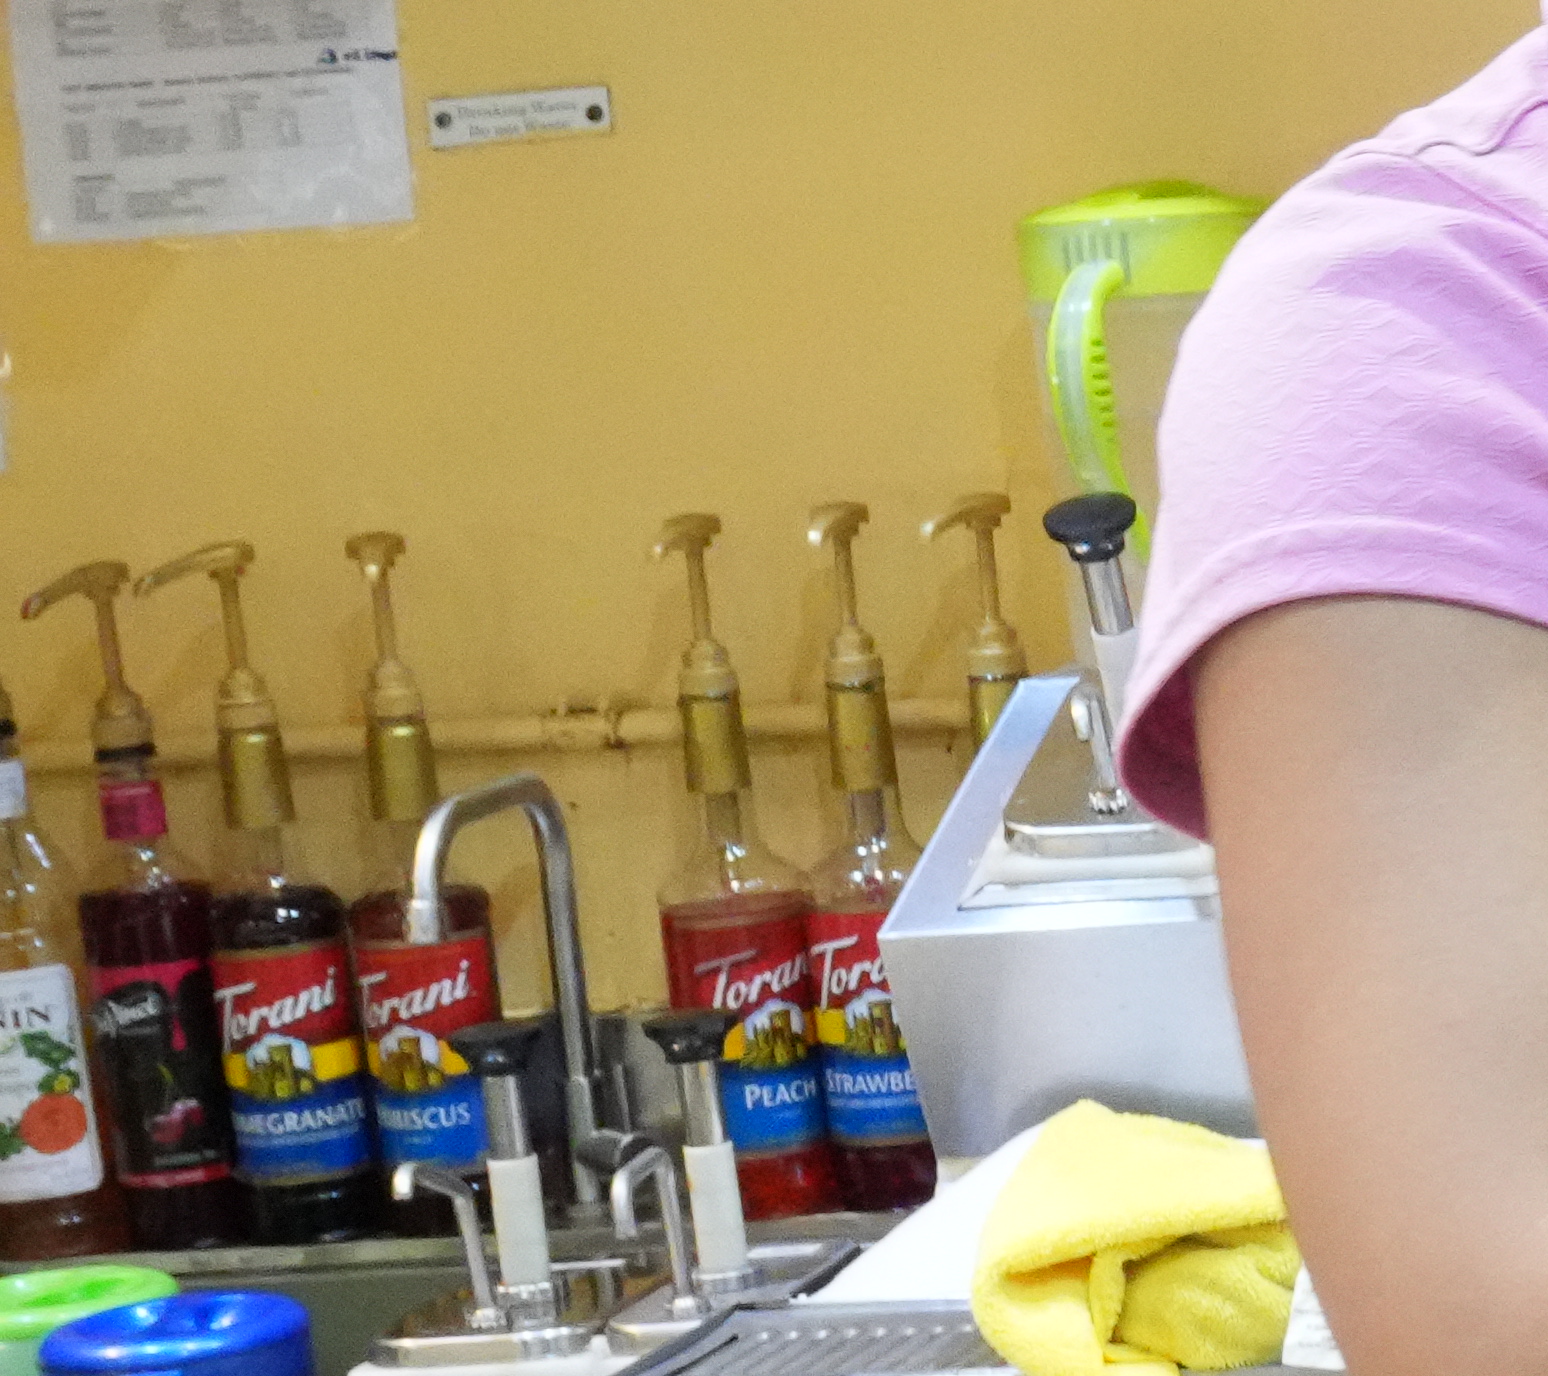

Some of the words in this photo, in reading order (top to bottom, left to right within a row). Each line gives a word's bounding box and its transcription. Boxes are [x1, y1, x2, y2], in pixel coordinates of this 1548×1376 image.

[213, 965, 337, 1055] Torani
[356, 959, 470, 1043] Torani
[744, 1077, 817, 1110] PEACH
